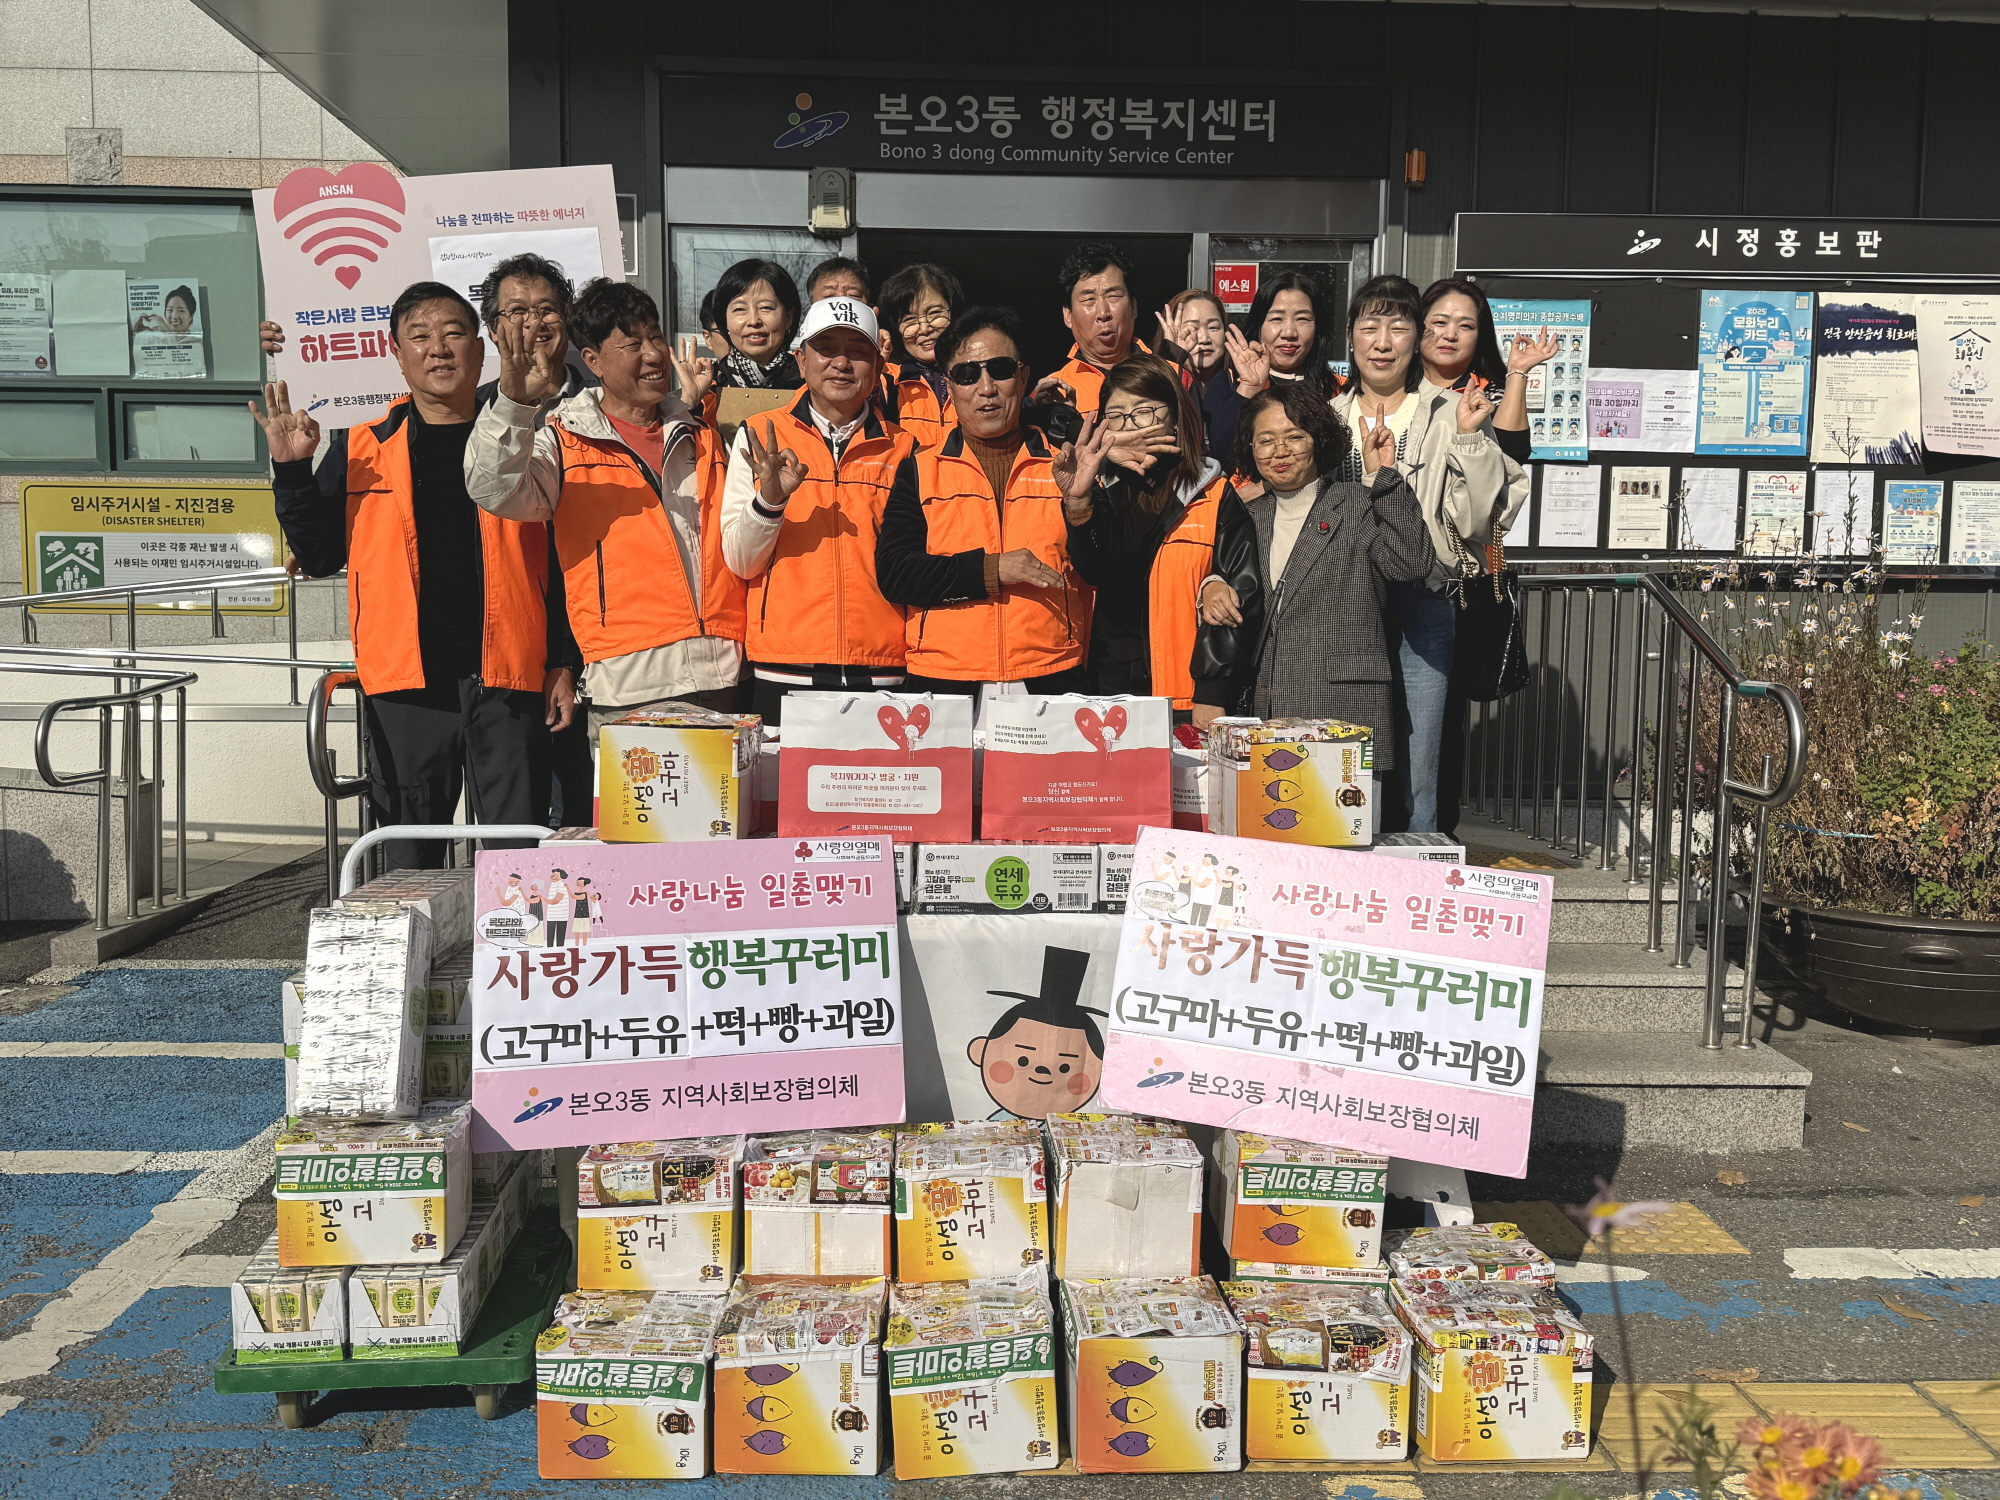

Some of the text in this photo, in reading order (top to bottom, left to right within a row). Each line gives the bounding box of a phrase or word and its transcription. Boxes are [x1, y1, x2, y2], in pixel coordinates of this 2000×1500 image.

[873, 93, 1276, 143] 본오3동 행정복지센터
[880, 142, 1234, 166] Bono 3 dong Community Service Center
[319, 184, 354, 198] ANSAN
[436, 206, 586, 228] 나눔을 전파하는 따뜻한 에너지
[1695, 227, 1882, 259] 시정홍보판
[1218, 279, 1250, 292] 에스원
[295, 304, 393, 326] 작은사랑 큰보
[828, 301, 853, 312] Vol
[1540, 312, 1584, 323] 종합공개수배
[1747, 307, 1767, 315] 2025
[833, 311, 860, 325] vik
[1733, 316, 1779, 329] 문화누리
[1744, 329, 1768, 341] 카드
[1824, 326, 1883, 341] 전국 안산읍성
[299, 329, 399, 363] 하트파
[1589, 399, 1639, 407] 11월 30일까지
[70, 496, 235, 514] 임시주거시설 지진겸용
[101, 515, 205, 527] (DISASTER SHELTER)
[140, 541, 238, 553] 이곳은 각종 재난 발생 시
[113, 557, 262, 569] 사용되는 이재민 임시주거시설입니다.
[660, 750, 680, 807] 고구마
[830, 772, 919, 782] 복지위기가구 발굴 지원
[630, 754, 657, 823] 아성 꿀
[1351, 818, 1362, 836] 10kg
[816, 841, 880, 854] 사랑의열매
[925, 875, 962, 884] 고칼슘 두유
[993, 867, 1024, 882] 연세
[1106, 874, 1127, 882] 고칼슘
[1467, 870, 1539, 892] 사랑의열매
[628, 873, 872, 911] 사랑나눔 일촌맺기
[925, 884, 952, 894] 검은콩
[994, 886, 1024, 901] 두유
[1271, 883, 1525, 938] 사랑나눔 일촌맺기
[487, 931, 890, 1000] 사랑가득 행복꾸러미
[1129, 924, 1532, 1028] 사랑가득 행복꾸러미
[568, 1073, 859, 1117] 본오3동 지역사회보장협의체
[1187, 1070, 1480, 1141] 본오3동 지역사회보장협의체
[279, 1156, 425, 1183] 일등할인마트
[1246, 1166, 1377, 1193] 일등할인마트
[963, 1178, 987, 1239] 고구마
[319, 1199, 344, 1243] 아성
[931, 1184, 959, 1261] 아성 꿀
[645, 1213, 669, 1252] 고구
[617, 1229, 638, 1270] 아성
[1356, 1240, 1370, 1258] 10kg
[396, 1292, 412, 1300] 연세
[893, 1337, 1036, 1379] 일등할인마트
[537, 1362, 677, 1389] 일등할인마트
[1506, 1353, 1530, 1418] 고구마
[963, 1385, 988, 1432] 고구
[1472, 1360, 1501, 1440] 아성 꿀
[1289, 1390, 1312, 1436] 아성
[936, 1411, 957, 1455] 아성
[675, 1447, 690, 1468] 10kg
[849, 1445, 864, 1466] 10kg
[1213, 1441, 1227, 1462] 10kg
